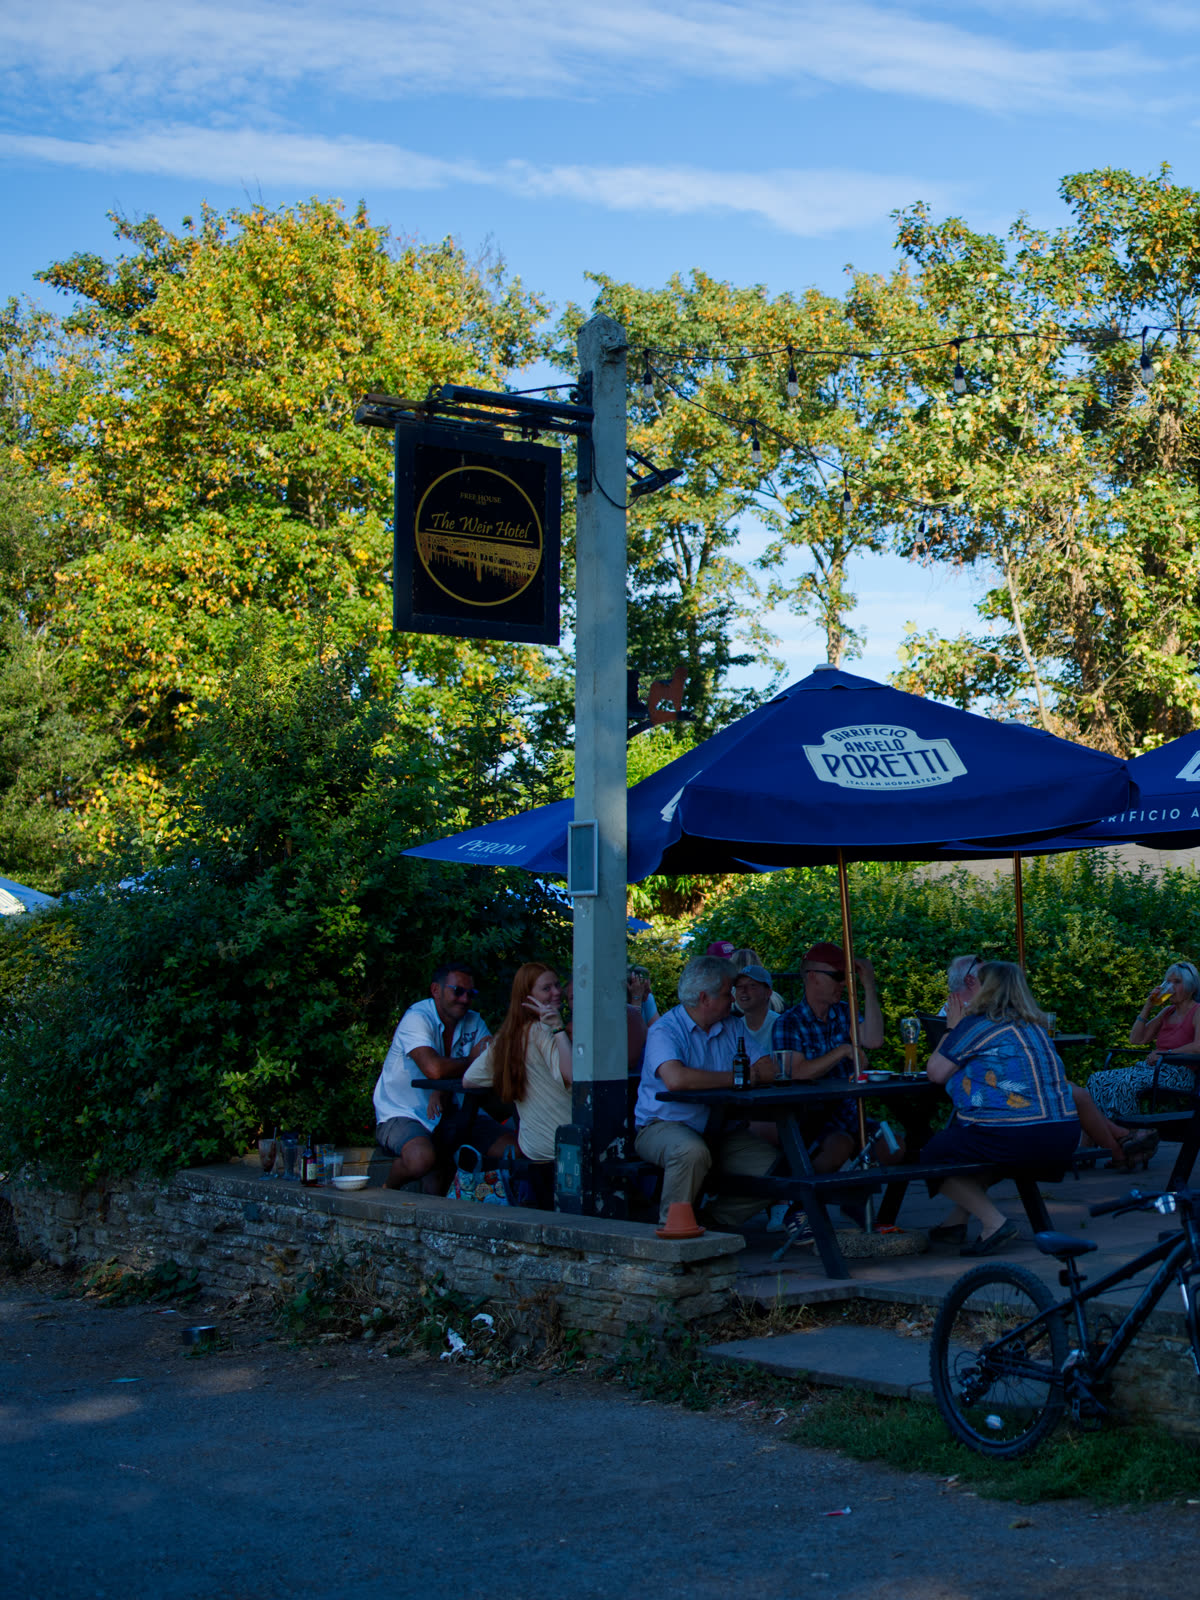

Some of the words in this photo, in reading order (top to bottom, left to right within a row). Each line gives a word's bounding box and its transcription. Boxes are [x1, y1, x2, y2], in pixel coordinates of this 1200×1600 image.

[460, 491, 476, 500] FREE
[477, 495, 502, 504] HOUSE
[431, 511, 456, 530] The
[459, 516, 494, 536] Weir
[496, 521, 533, 540] Hotel
[831, 727, 908, 743] BIRRIFICIO
[844, 738, 905, 753] ANGELO
[821, 748, 949, 778] PORETTI
[457, 839, 527, 855] PERONI
